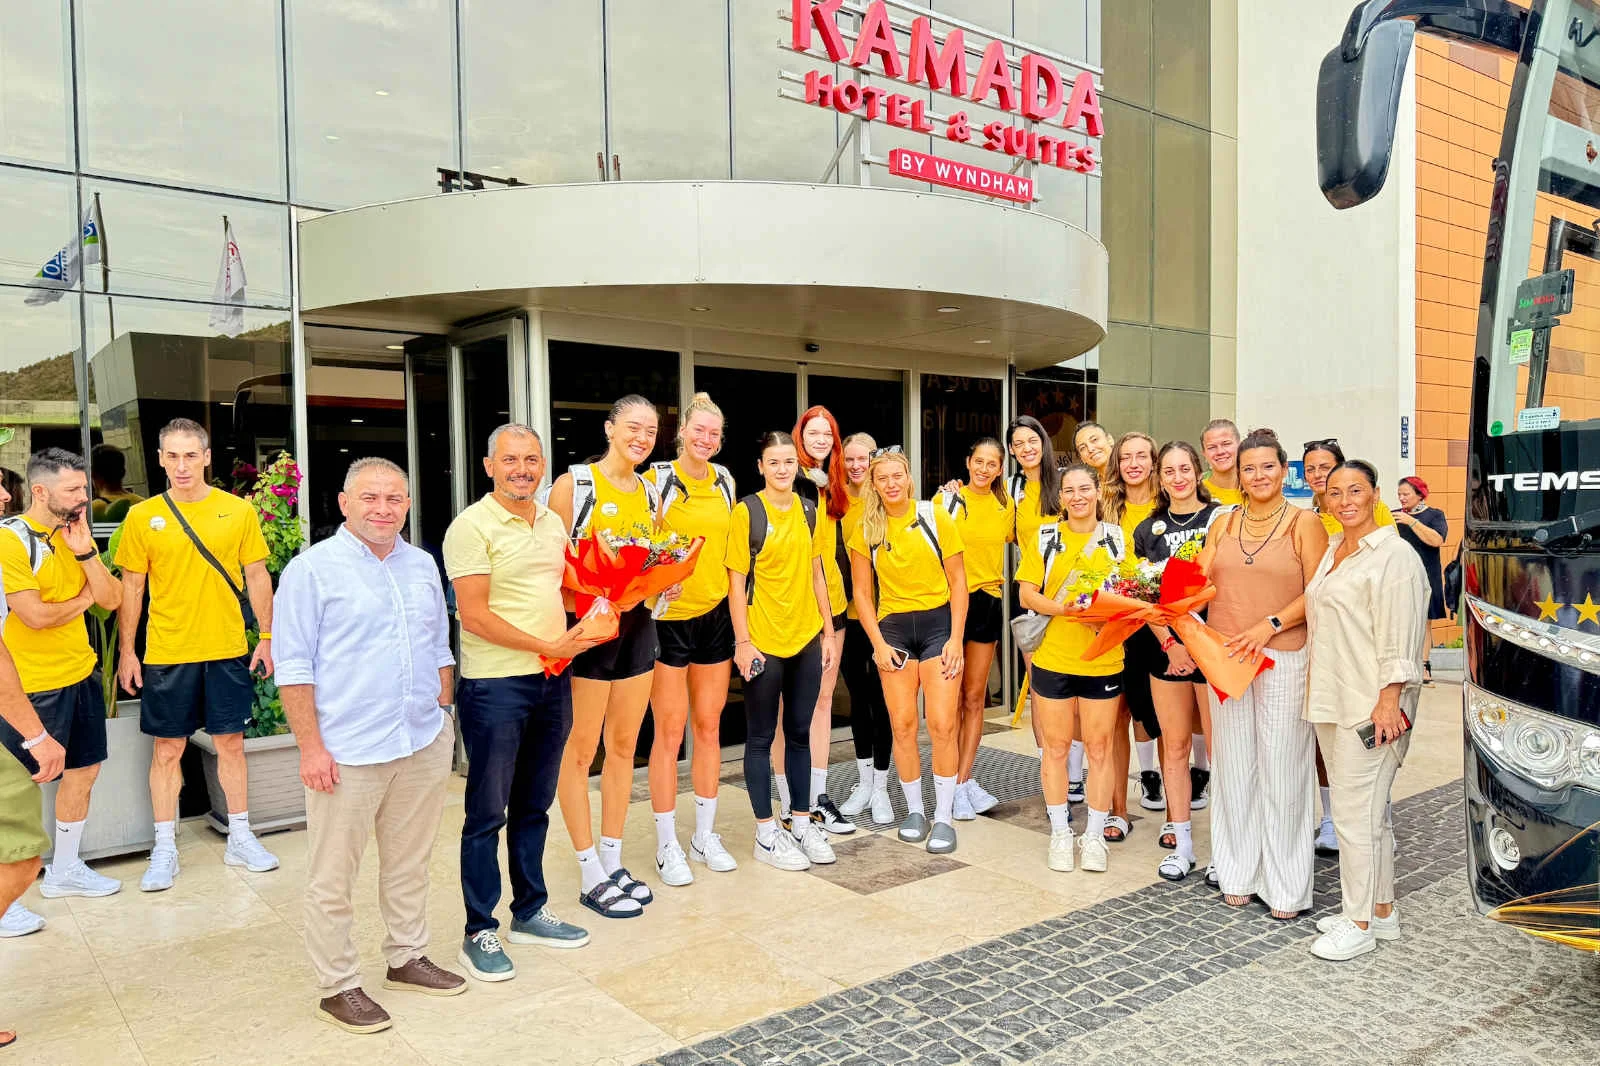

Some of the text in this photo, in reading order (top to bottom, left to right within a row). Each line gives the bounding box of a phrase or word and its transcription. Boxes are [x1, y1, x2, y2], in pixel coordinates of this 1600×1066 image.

[792, 0, 1104, 136] RAMADA
[805, 69, 1096, 172] HOTEL & SUITES
[900, 153, 1030, 198] BY WYNDHAM
[1487, 470, 1600, 492] TEMS
